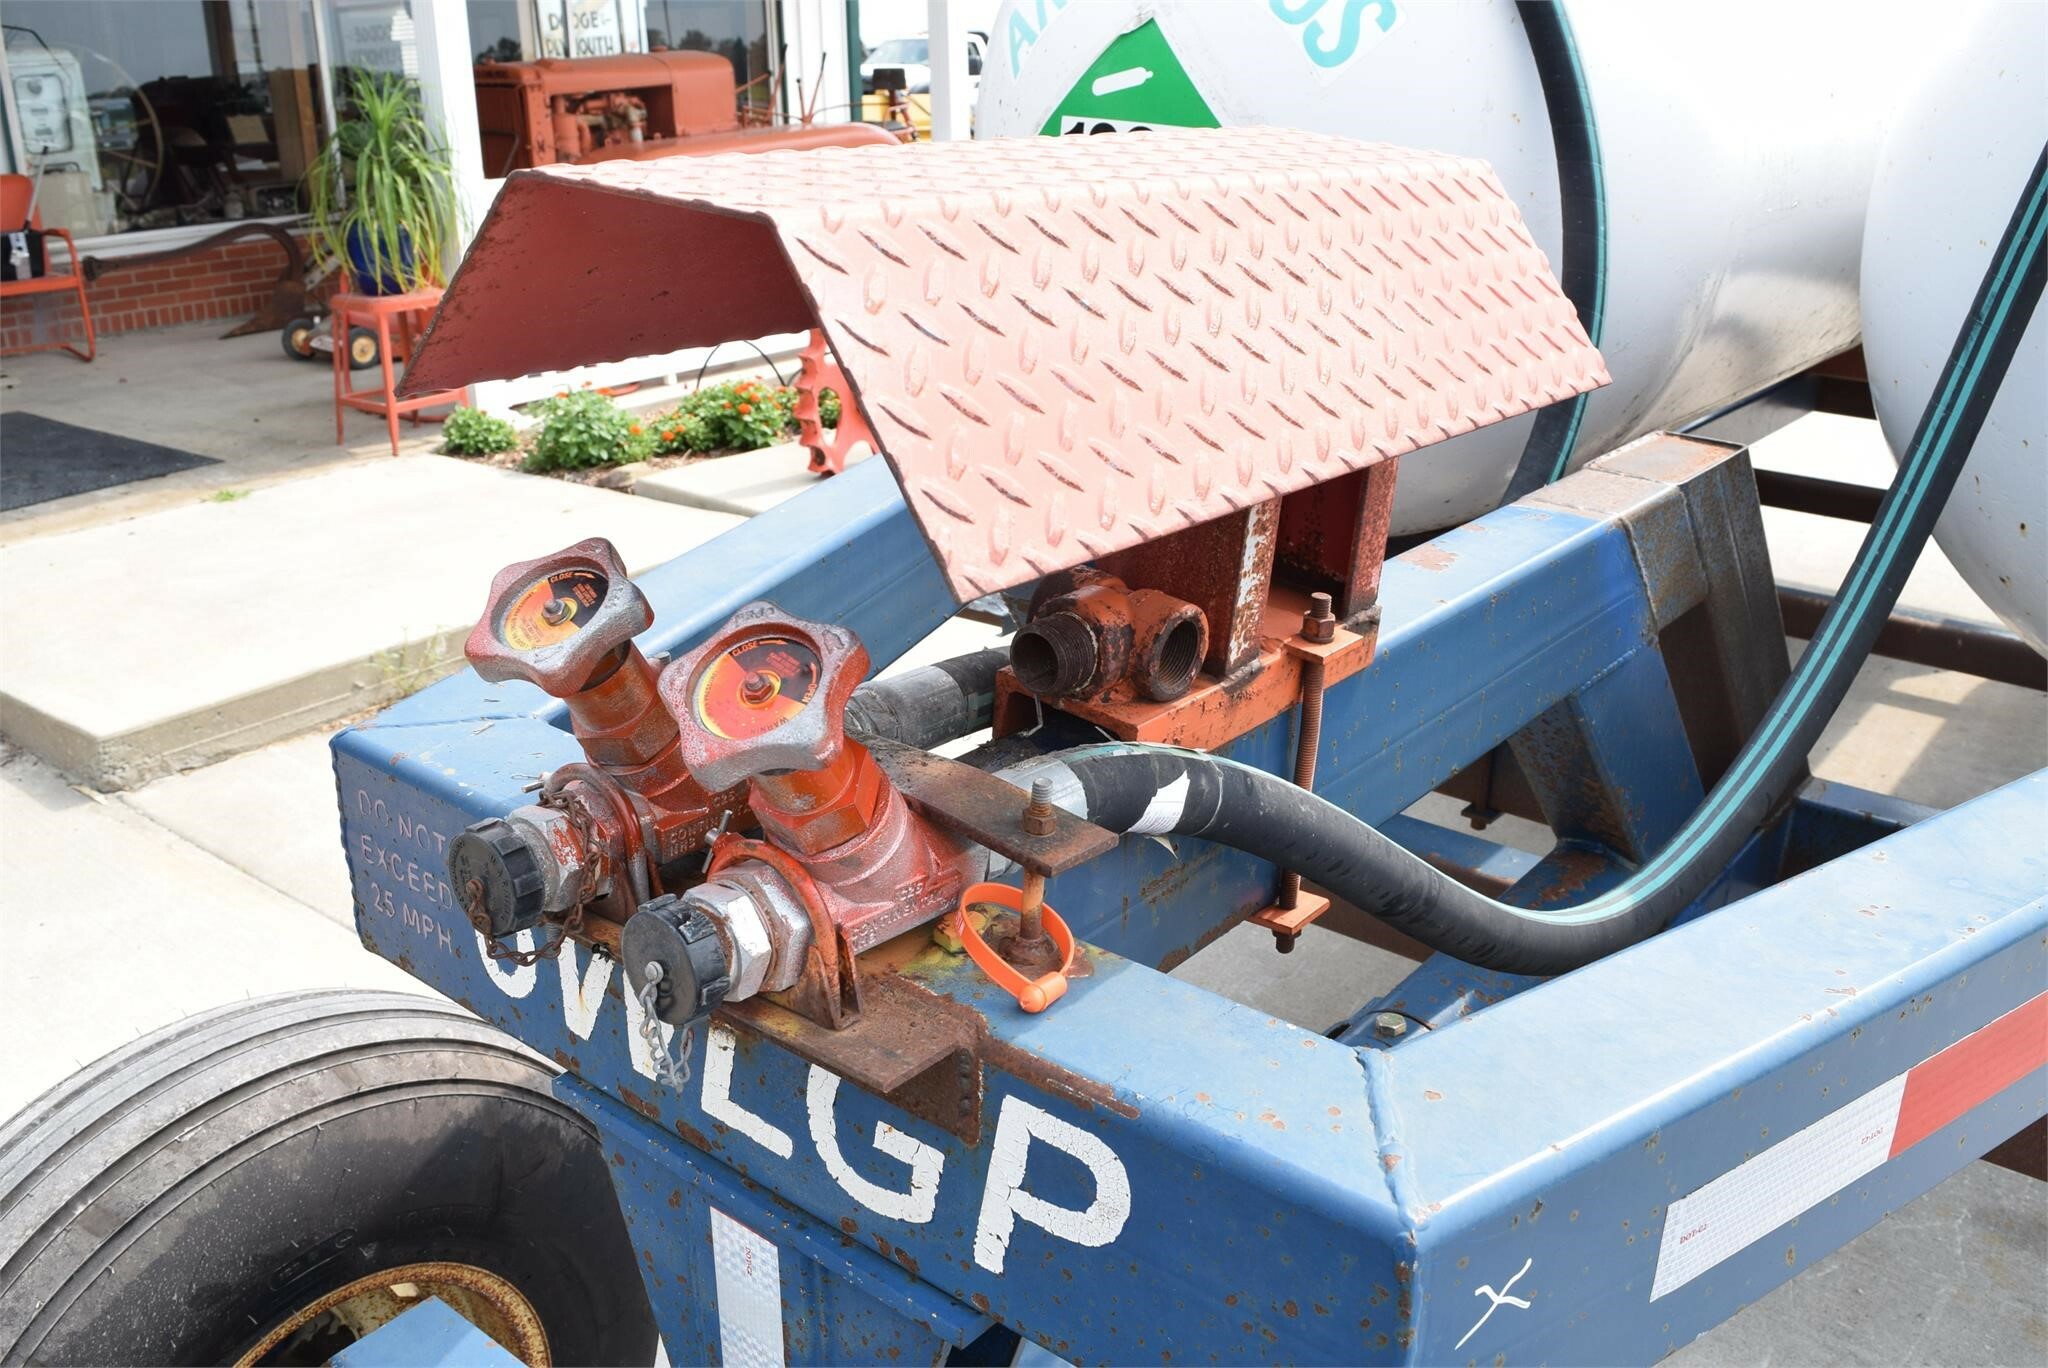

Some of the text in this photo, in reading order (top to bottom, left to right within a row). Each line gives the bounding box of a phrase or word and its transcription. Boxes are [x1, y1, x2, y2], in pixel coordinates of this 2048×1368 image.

[548, 11, 598, 31] DGE
[550, 571, 574, 584] CLOSE
[732, 641, 759, 657] CLOSE
[801, 683, 818, 703] OPEN
[358, 789, 447, 854] DO NOT
[361, 834, 453, 910] EXCEED
[371, 882, 453, 953] 25 MPH
